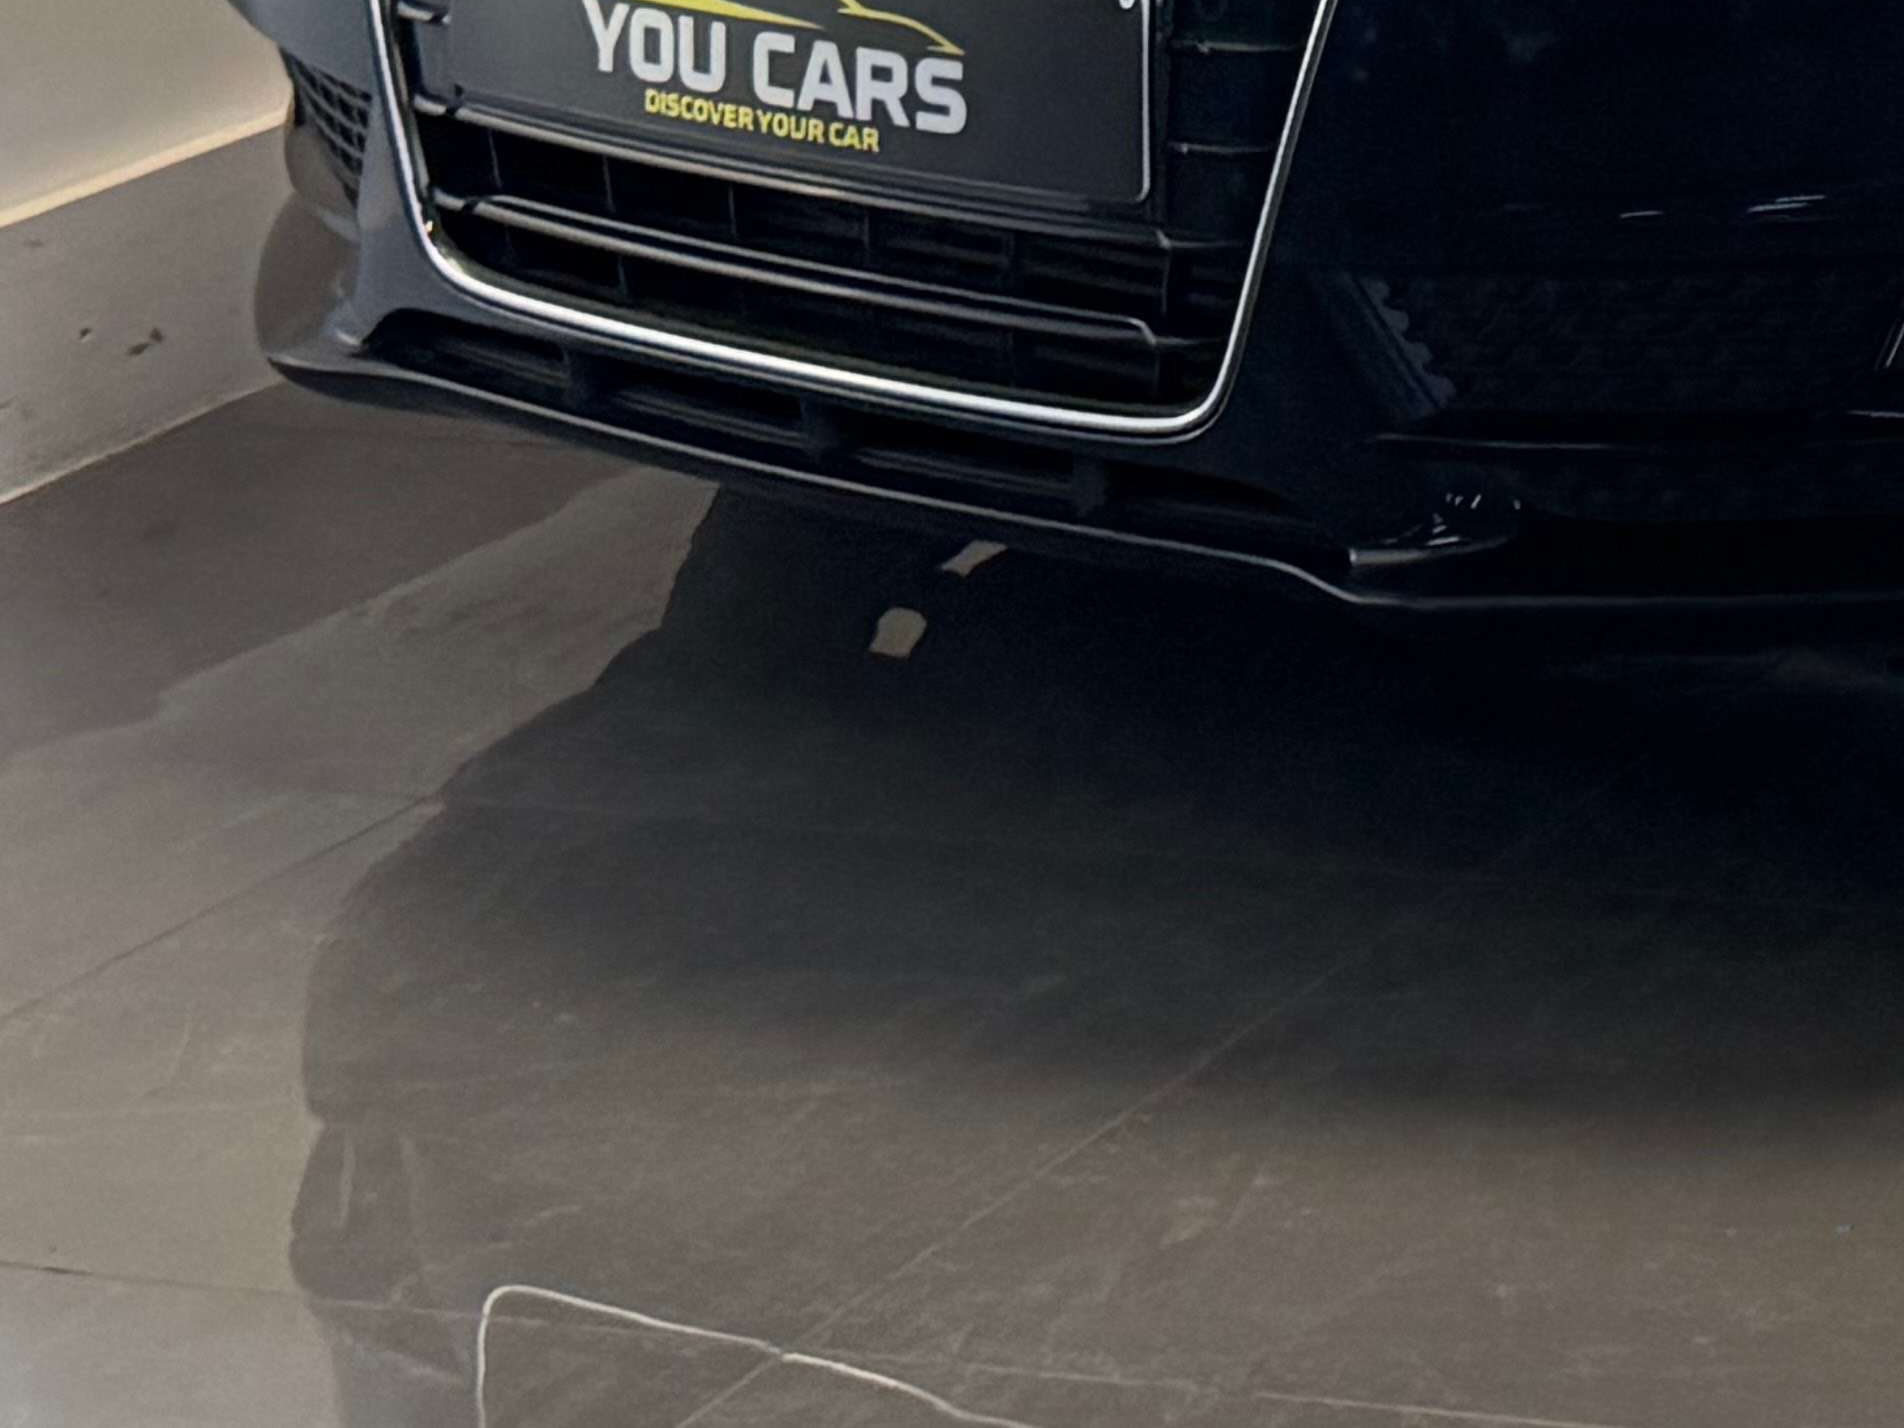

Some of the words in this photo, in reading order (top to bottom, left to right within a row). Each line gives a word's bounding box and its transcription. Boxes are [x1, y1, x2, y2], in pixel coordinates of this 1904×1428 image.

[644, 87, 754, 131] DISCOVER
[755, 108, 825, 144] YOUR
[828, 121, 881, 153] CAR
[752, 31, 968, 135] CARS
